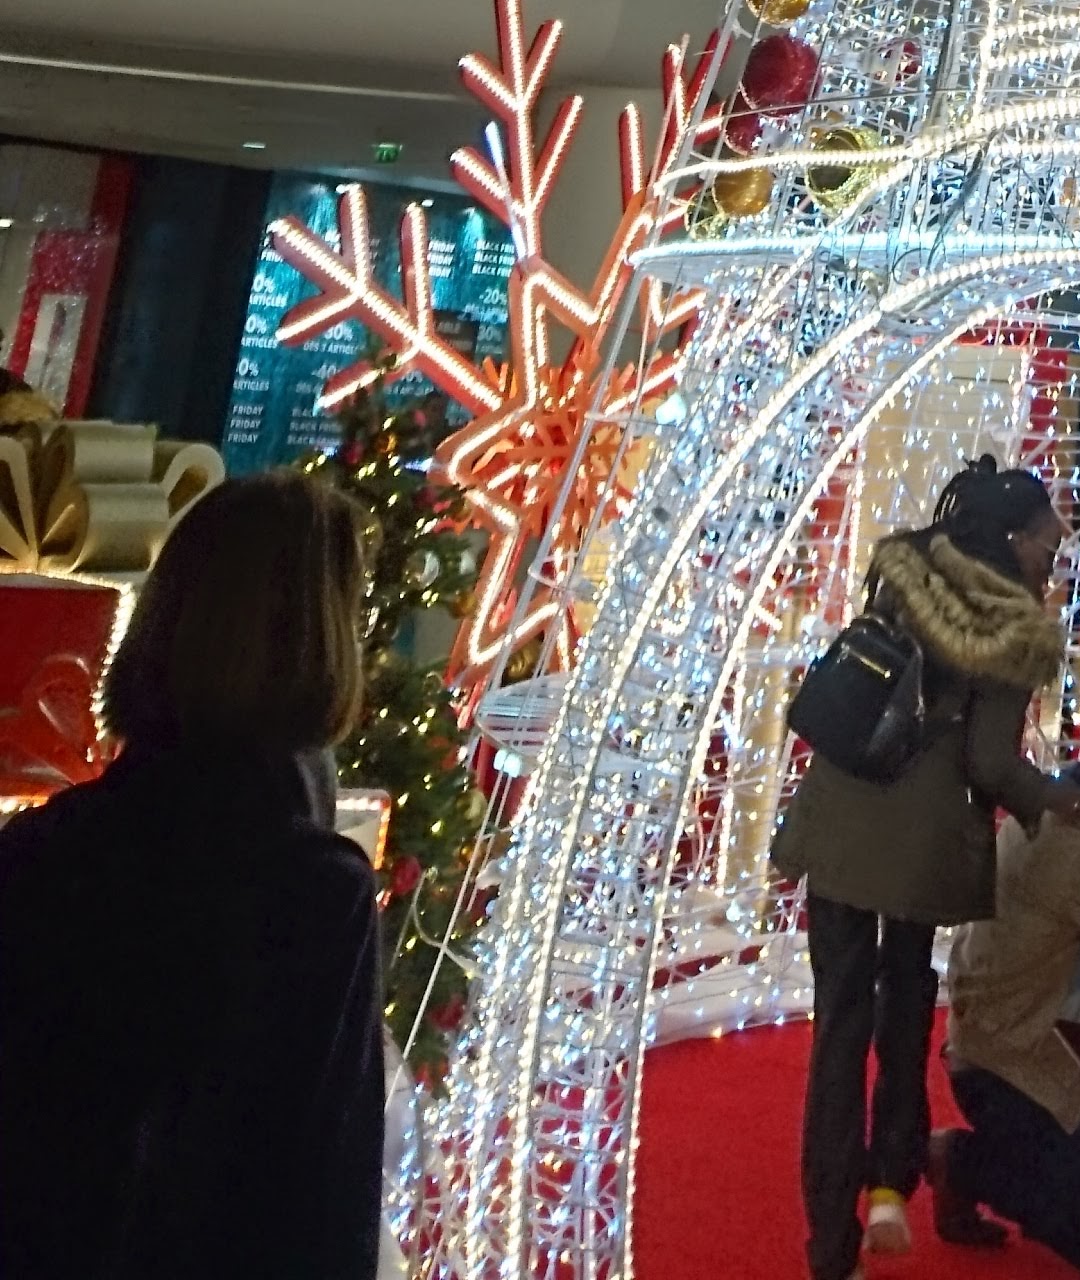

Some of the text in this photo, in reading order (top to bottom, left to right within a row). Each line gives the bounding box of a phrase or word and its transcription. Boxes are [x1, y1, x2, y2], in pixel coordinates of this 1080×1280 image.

[474, 251, 498, 264] BLACK
[472, 262, 496, 276] BLACK
[232, 405, 264, 416] FRIDAY
[230, 419, 261, 430] FRIDAY
[228, 433, 259, 444] FRIDAY
